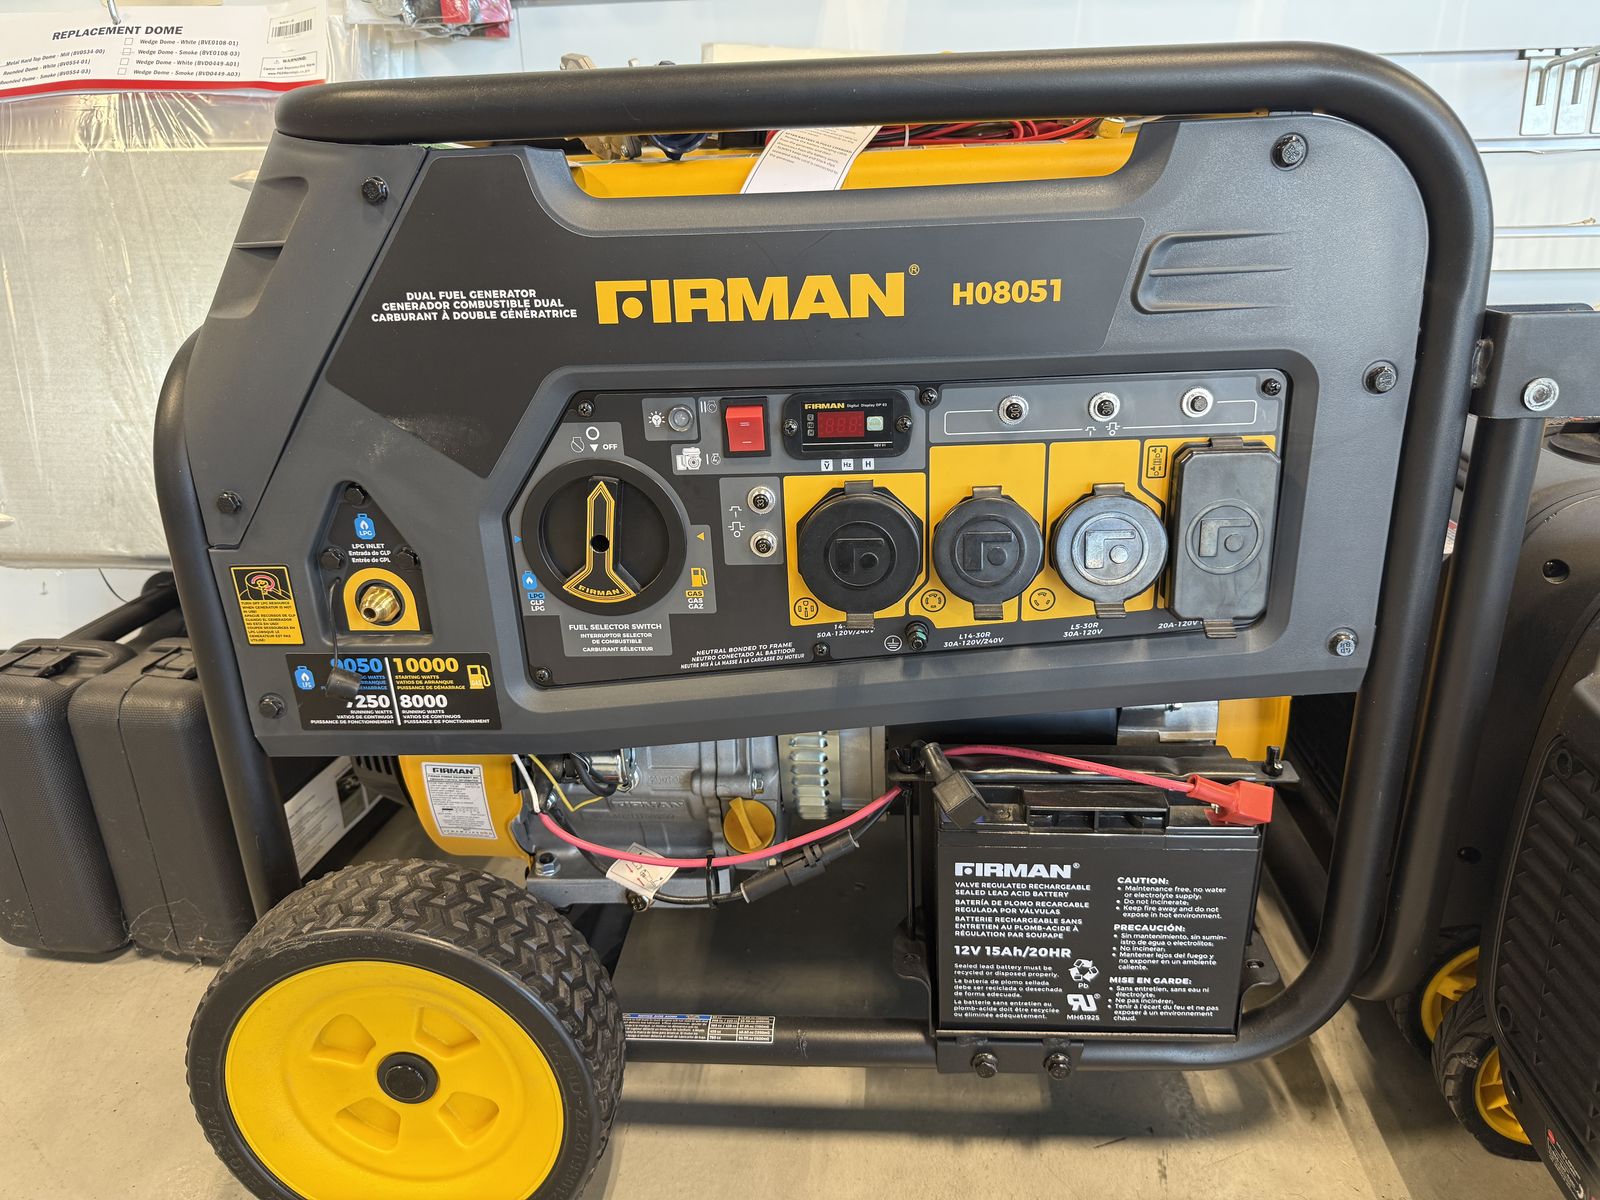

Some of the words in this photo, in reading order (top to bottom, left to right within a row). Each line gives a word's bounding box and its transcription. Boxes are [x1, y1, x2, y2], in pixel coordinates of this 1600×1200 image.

[52, 26, 141, 40] REPLACEMENT
[145, 26, 183, 34] DOME
[406, 291, 436, 301] DUAL
[439, 290, 466, 300] FUEL
[469, 289, 536, 299] GENERATOR
[595, 272, 905, 324] FIRMAN
[952, 278, 1062, 306] H08051
[382, 301, 450, 311] GENERADOR
[453, 299, 531, 309] COMBUSTIBLE
[534, 298, 564, 308] DUAL
[371, 312, 438, 322] CARBURANT
[442, 309, 450, 321] À
[453, 310, 497, 320] DOUBLE
[501, 308, 577, 319] GÉNÉRATRICE
[578, 585, 620, 596] FIRMAN
[1063, 629, 1103, 637] 30A-120V
[944, 638, 1004, 647] 30A-120V/240V
[717, 652, 754, 660] CONECTADO
[393, 658, 458, 672] 10000
[400, 695, 448, 708] 8000
[955, 862, 1071, 878] FIRMAN
[1114, 924, 1185, 932] PRECAUCIÓN:
[954, 946, 981, 956] 12V
[985, 946, 1071, 958] 15Ah/20HR
